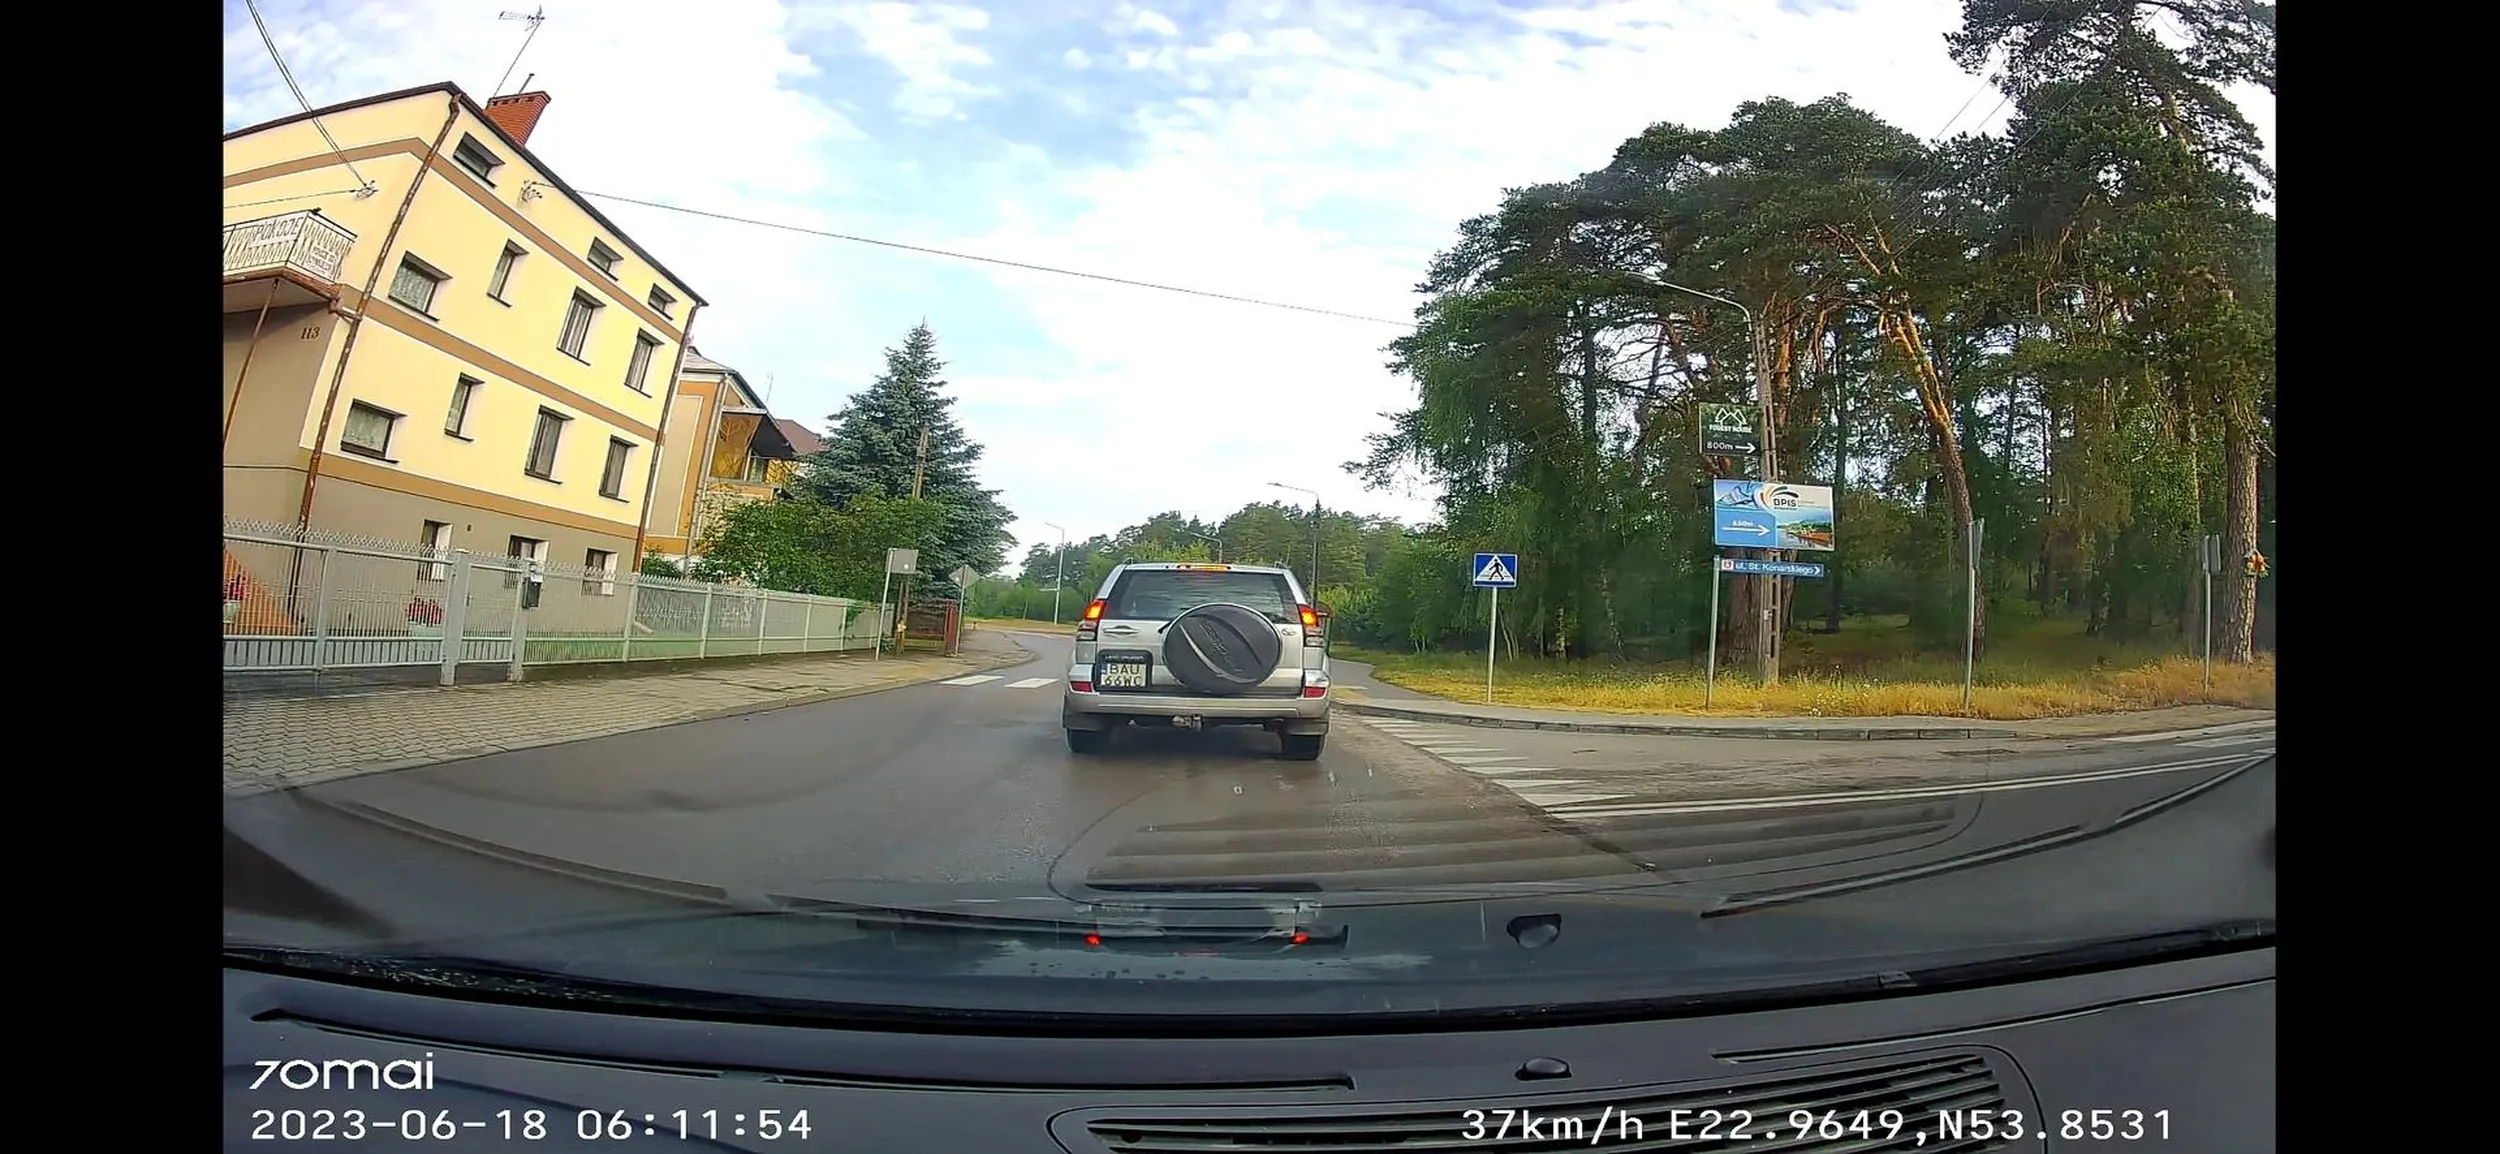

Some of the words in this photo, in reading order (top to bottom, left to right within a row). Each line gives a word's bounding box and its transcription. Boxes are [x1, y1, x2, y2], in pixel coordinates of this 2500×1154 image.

[301, 326, 321, 340] 113
[1706, 441, 1733, 450] 800m
[1109, 664, 1141, 675] BAU
